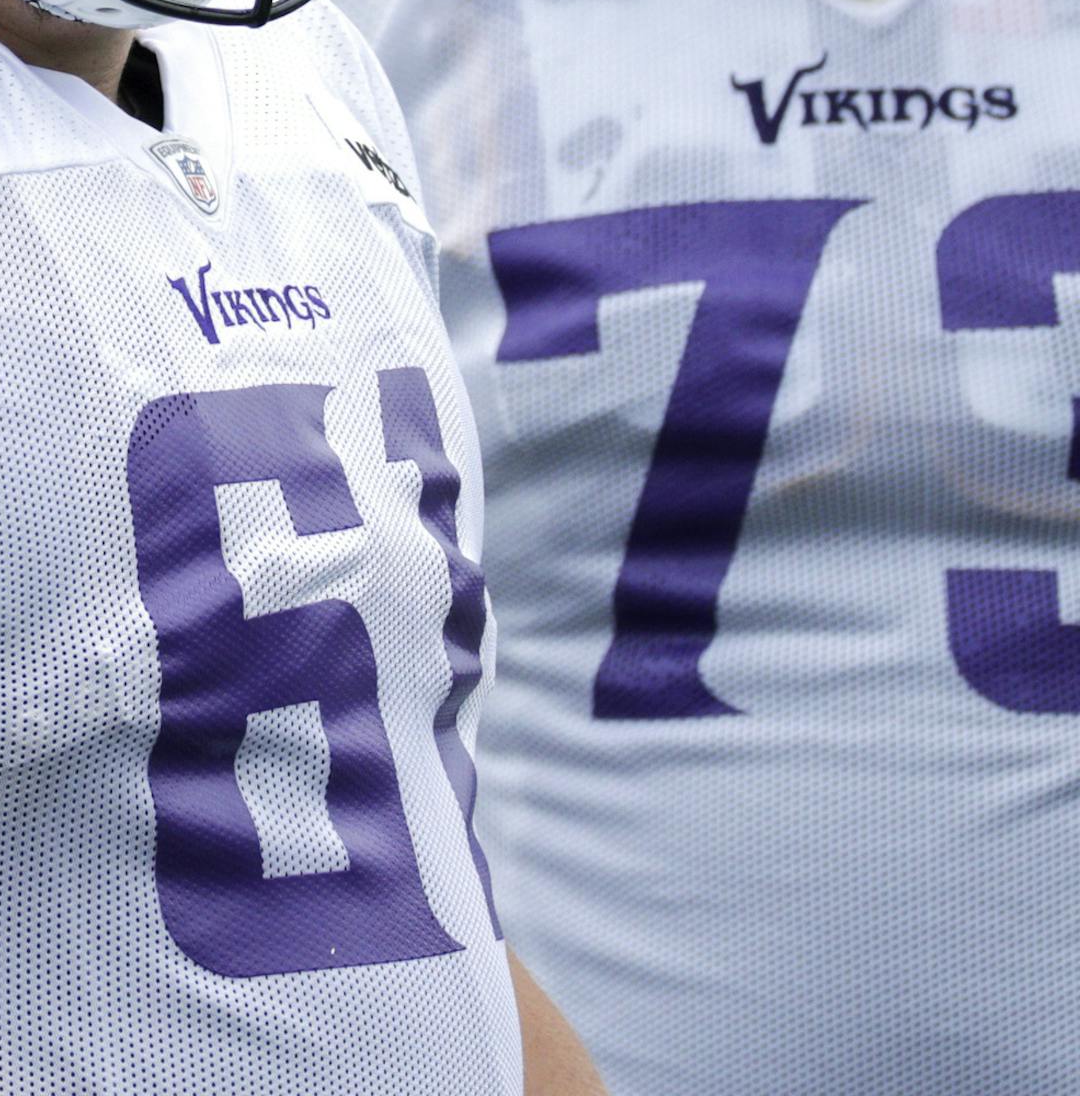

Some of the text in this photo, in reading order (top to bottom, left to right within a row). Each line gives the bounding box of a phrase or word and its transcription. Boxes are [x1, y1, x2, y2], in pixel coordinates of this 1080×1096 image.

[730, 51, 1018, 144] VIKINGS
[165, 258, 331, 344] VIKINGS
[126, 366, 504, 978] 61
